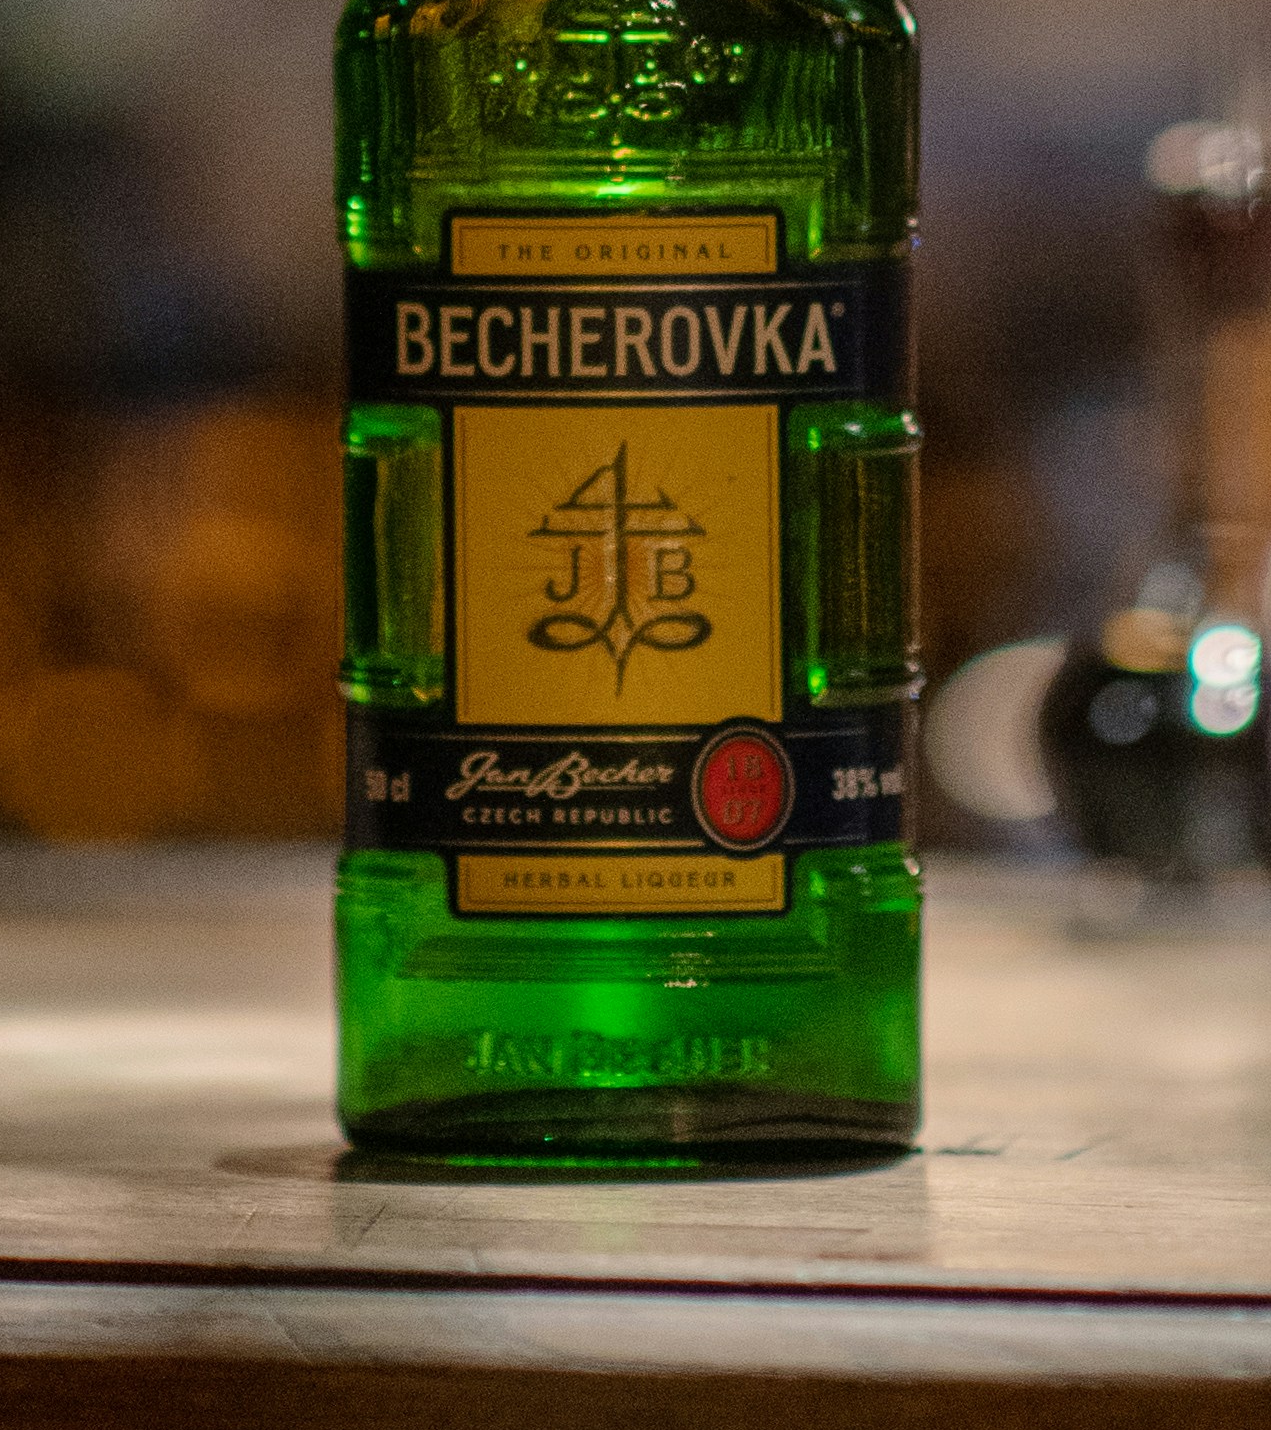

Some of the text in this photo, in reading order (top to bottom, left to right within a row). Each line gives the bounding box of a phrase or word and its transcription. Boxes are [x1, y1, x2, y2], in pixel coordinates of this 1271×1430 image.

[498, 243, 732, 261] THE ORIGINAL
[395, 301, 838, 378] BECHEROVKA
[462, 807, 674, 825] CZECH REPUBLIC
[504, 872, 736, 889] HERBAL LIQUEUR
